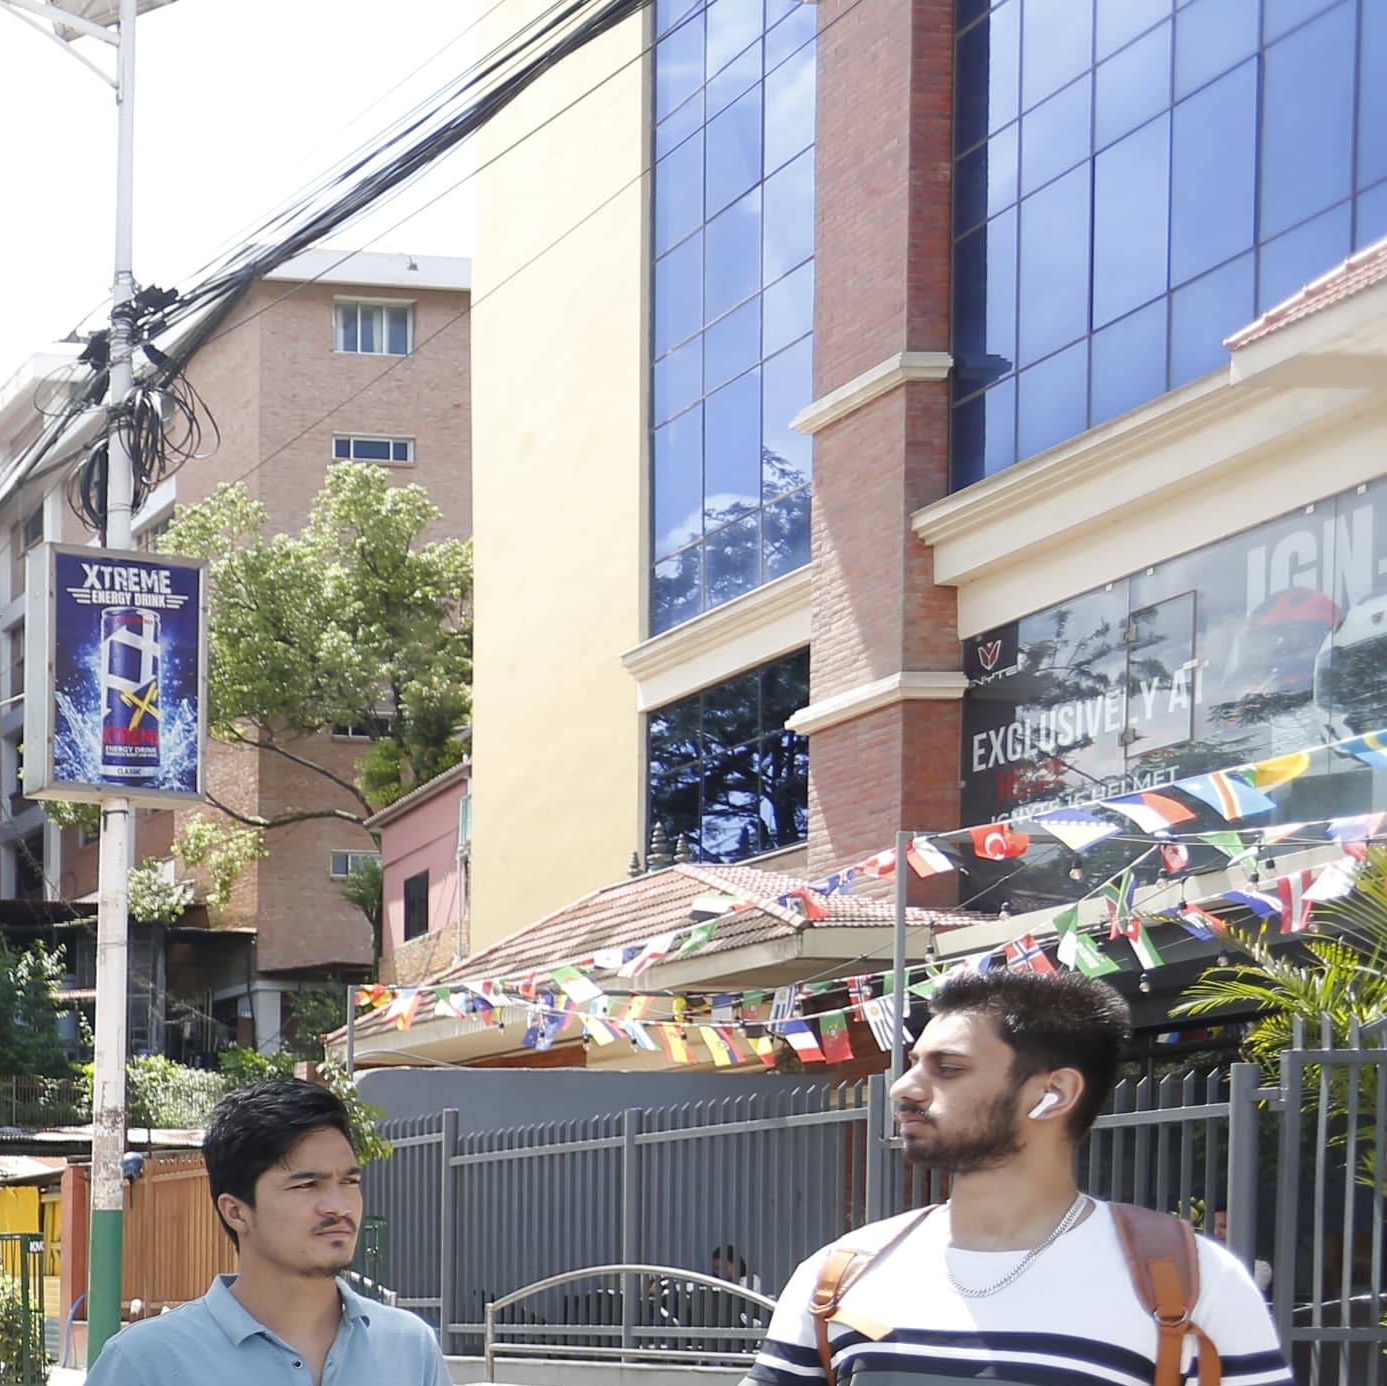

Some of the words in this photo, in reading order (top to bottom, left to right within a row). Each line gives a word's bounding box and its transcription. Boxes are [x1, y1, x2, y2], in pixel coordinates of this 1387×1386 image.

[81, 563, 172, 594] XTREME
[91, 590, 131, 605] ENERGY
[134, 593, 166, 608] DRINK
[972, 676, 1158, 773] EXCLUSIVELY
[1168, 658, 1210, 713] AT
